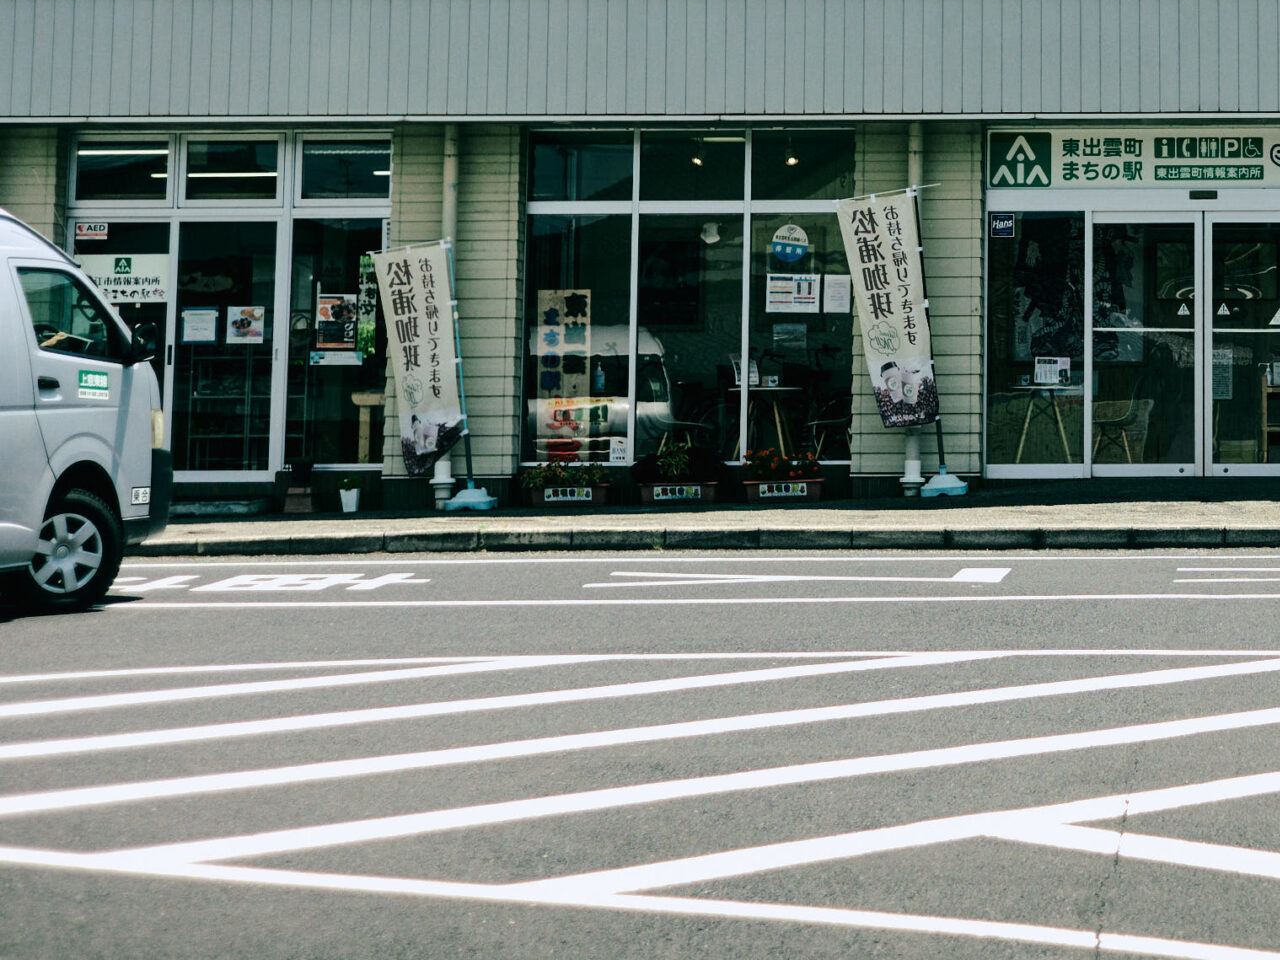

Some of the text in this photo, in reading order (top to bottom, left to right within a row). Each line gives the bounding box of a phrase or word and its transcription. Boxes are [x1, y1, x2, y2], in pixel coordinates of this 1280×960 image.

[1061, 137, 1144, 158] 東出雲町
[1061, 161, 1144, 182] まちの駅
[1156, 166, 1262, 180] 東出雲町情報案内所
[86, 224, 106, 232] AED
[992, 219, 1013, 230] Hans
